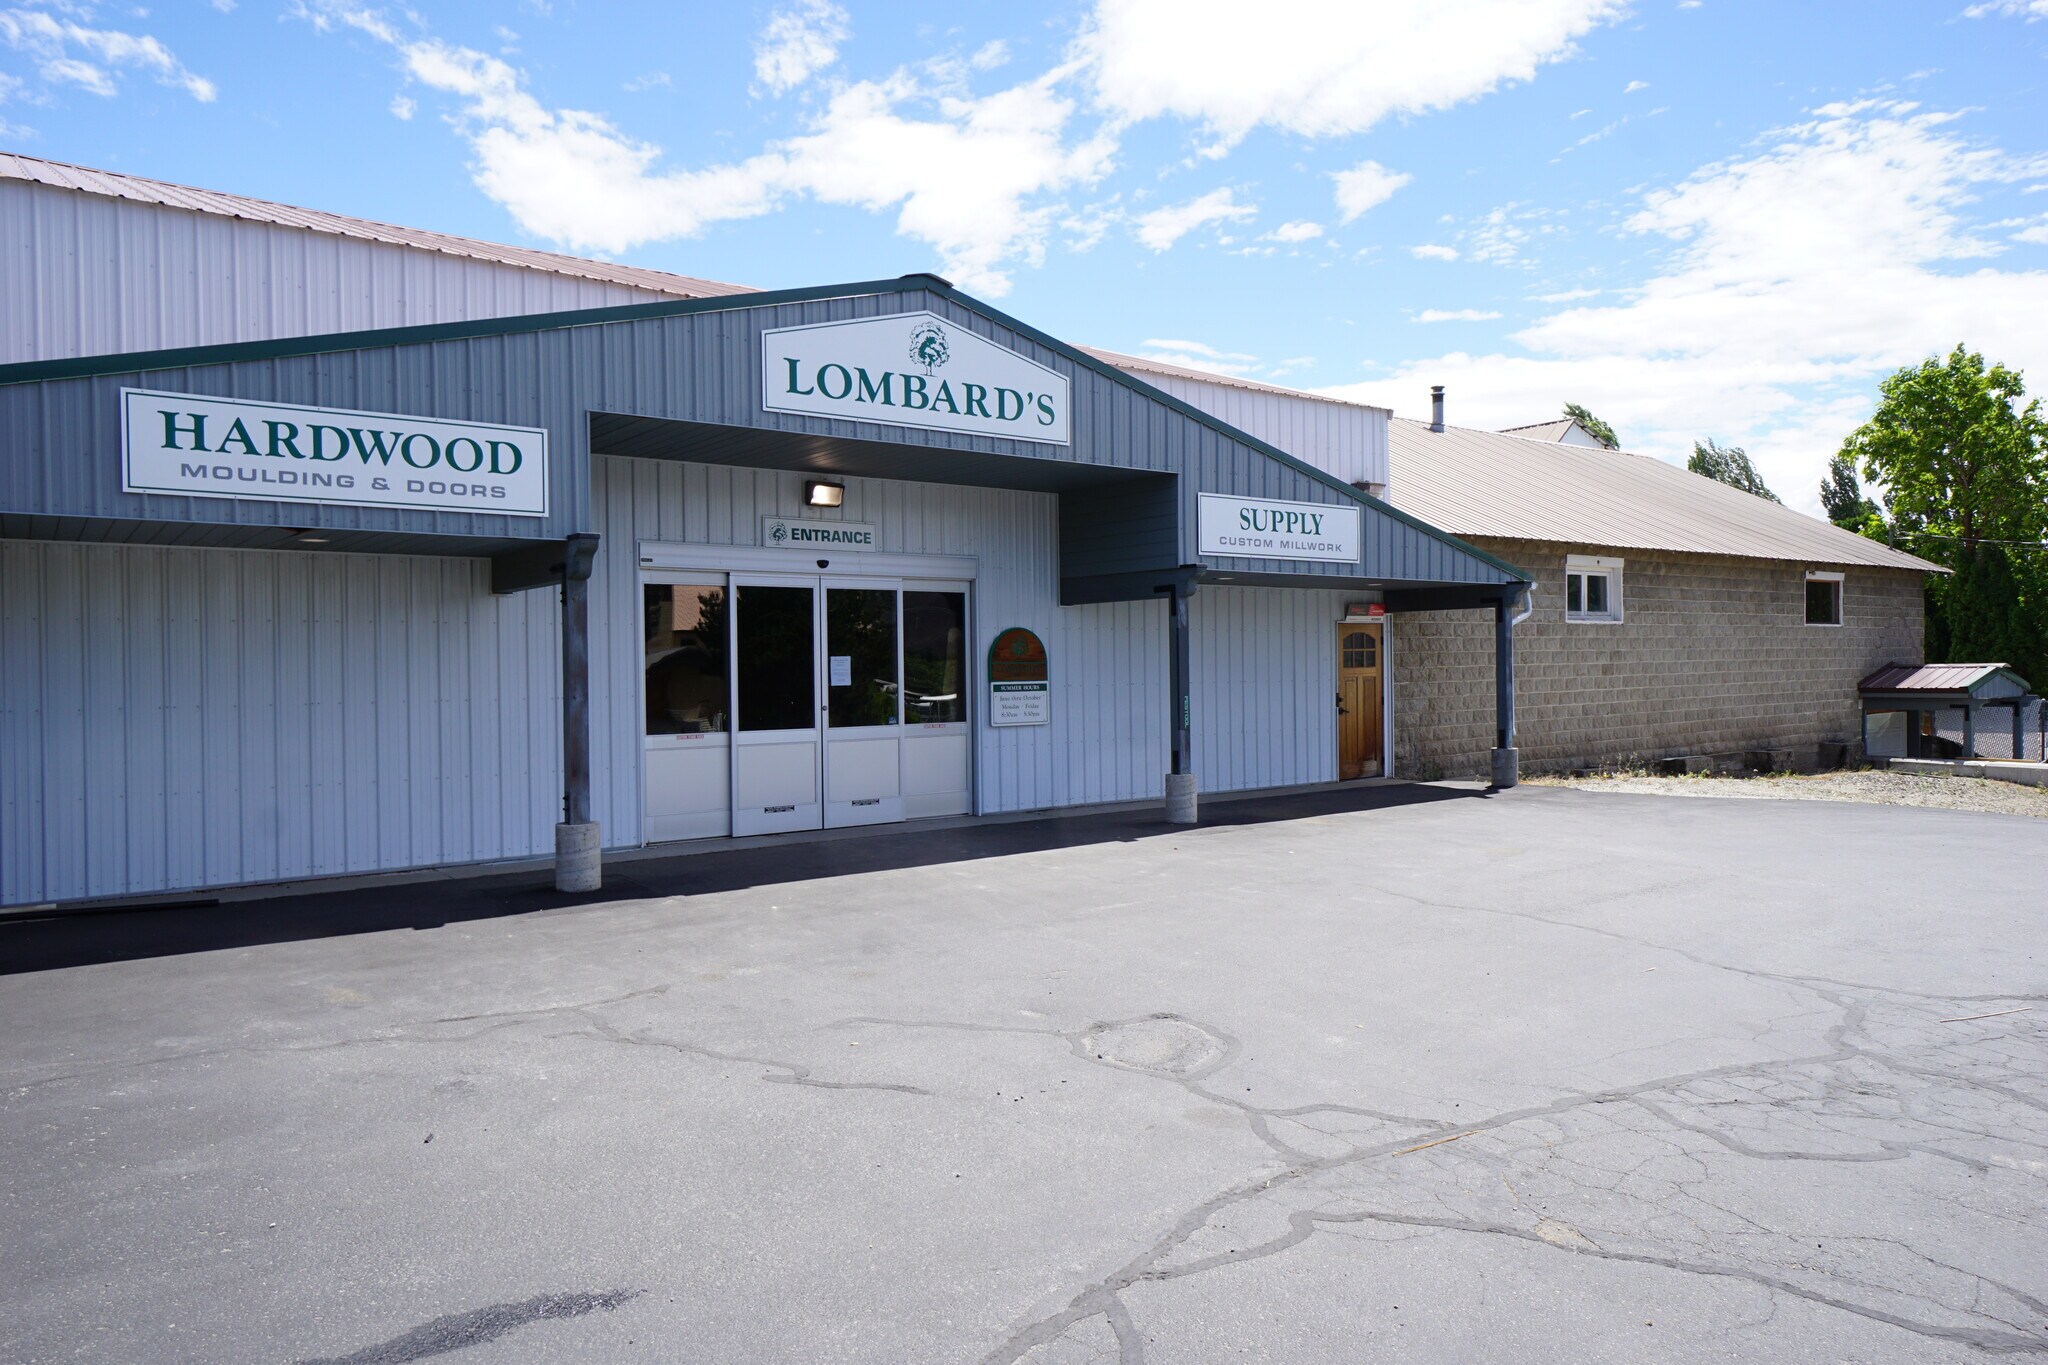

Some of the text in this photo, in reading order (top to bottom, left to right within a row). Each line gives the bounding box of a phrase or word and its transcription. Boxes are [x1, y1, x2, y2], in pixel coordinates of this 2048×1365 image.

[783, 357, 1055, 426] LOMBARD'S
[157, 410, 522, 475] HARDWOOD
[180, 463, 506, 499] MOULDING & DOORS
[791, 527, 871, 544] ENTRANCE
[1239, 507, 1324, 535] SUPPLY
[1219, 536, 1342, 552] CUSTOM MILLWORK
